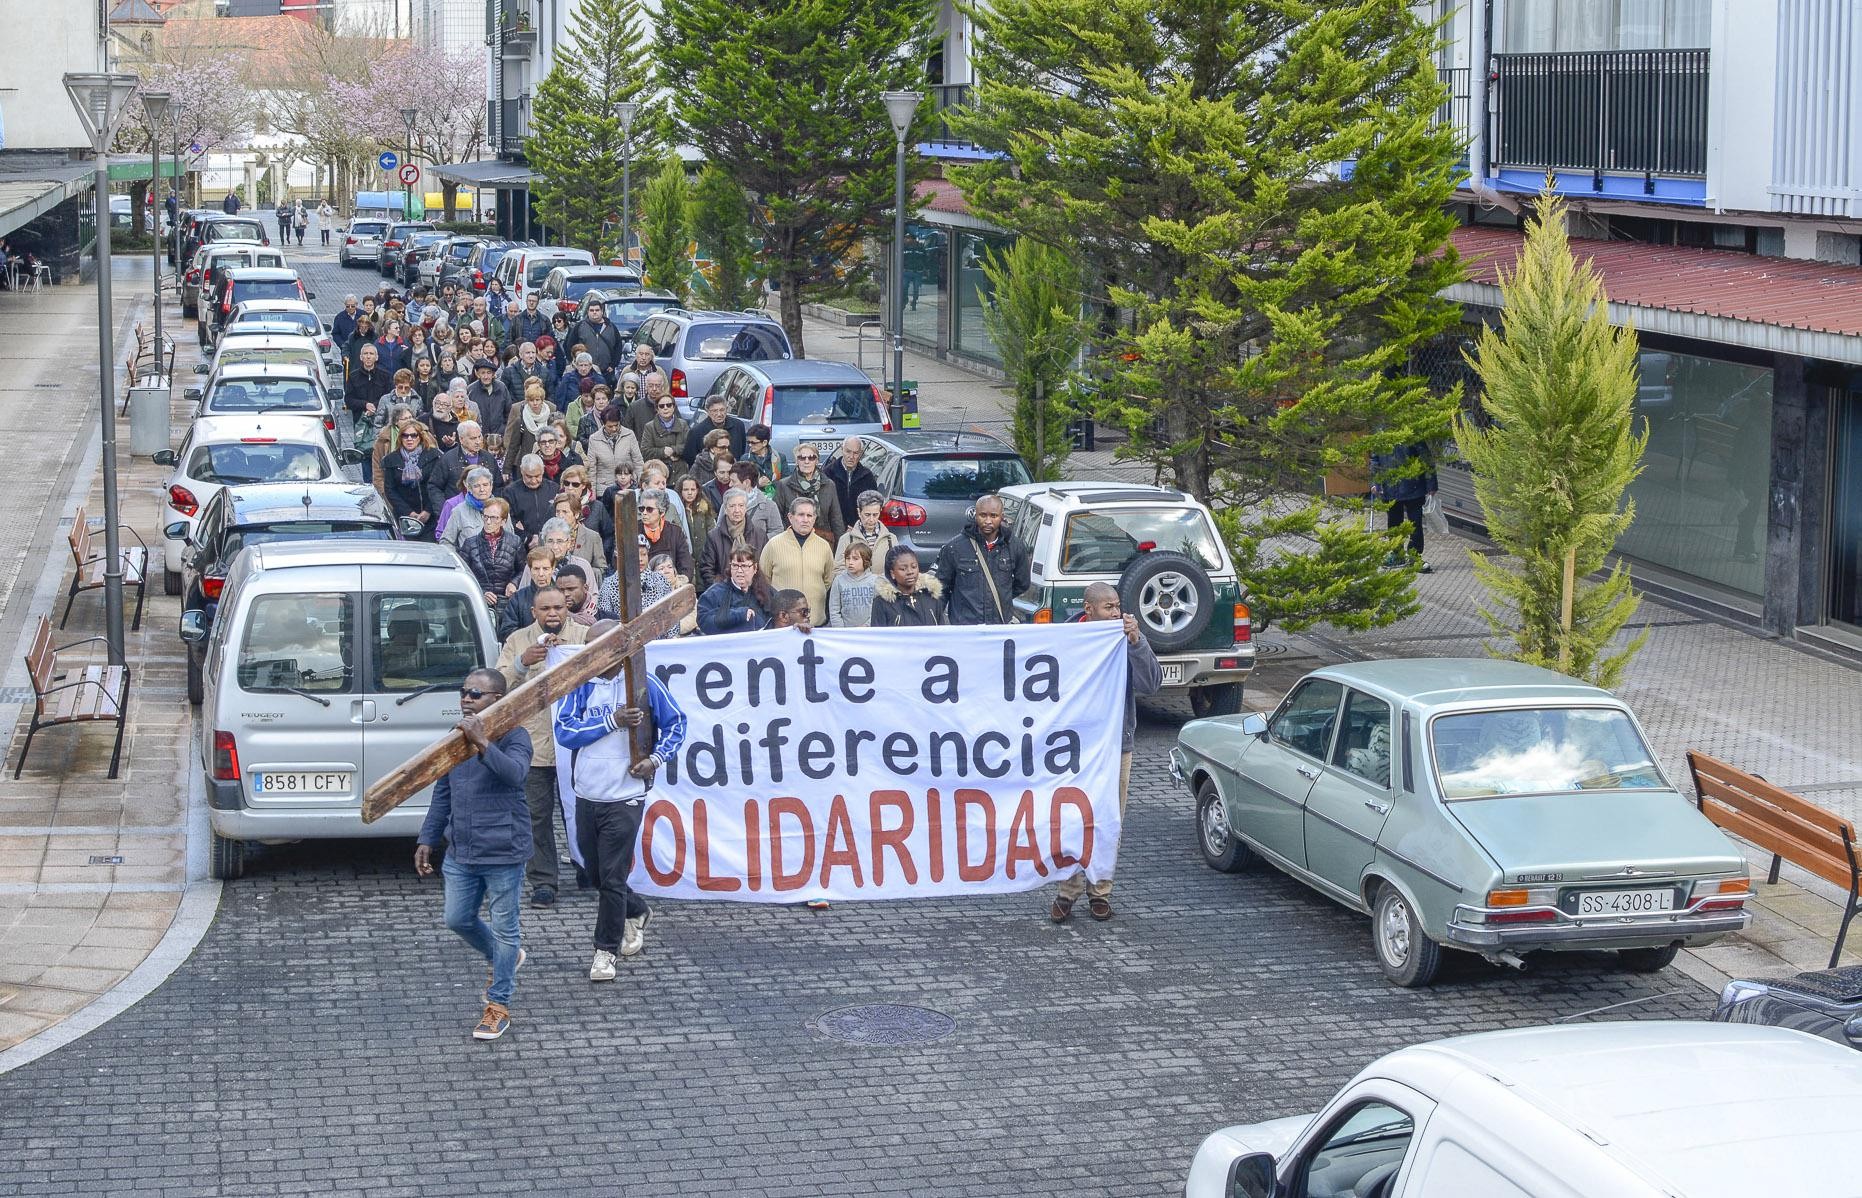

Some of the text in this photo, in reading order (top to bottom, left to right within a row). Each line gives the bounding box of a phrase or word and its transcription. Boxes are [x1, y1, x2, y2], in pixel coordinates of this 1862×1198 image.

[654, 638, 1060, 711] rente a la
[264, 774, 347, 790] 8581 CFY
[665, 716, 1081, 787] diferencia
[632, 786, 1095, 892] OLIDARIDAD
